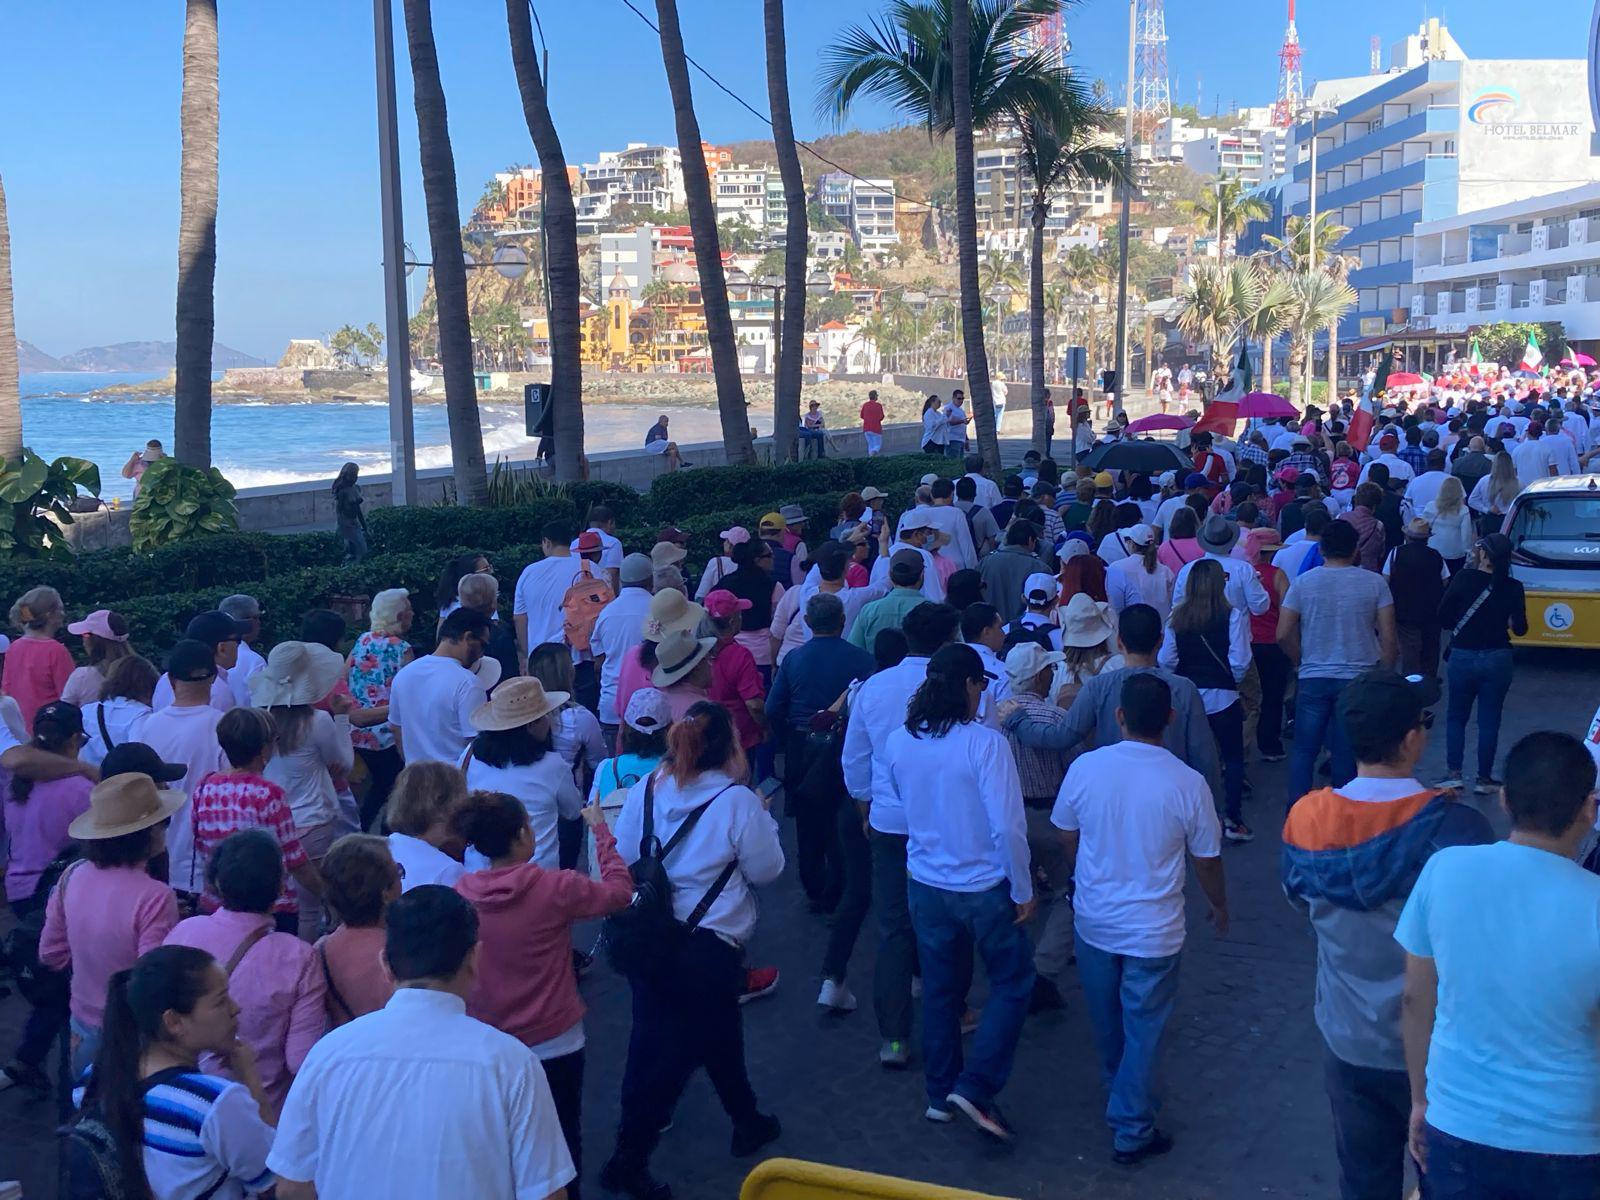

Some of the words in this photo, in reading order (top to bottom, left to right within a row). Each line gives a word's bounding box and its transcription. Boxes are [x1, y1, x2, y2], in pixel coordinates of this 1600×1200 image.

[1484, 125, 1526, 135] HOTEL
[1530, 125, 1579, 135] BELMAR
[1574, 546, 1600, 554] KIA
